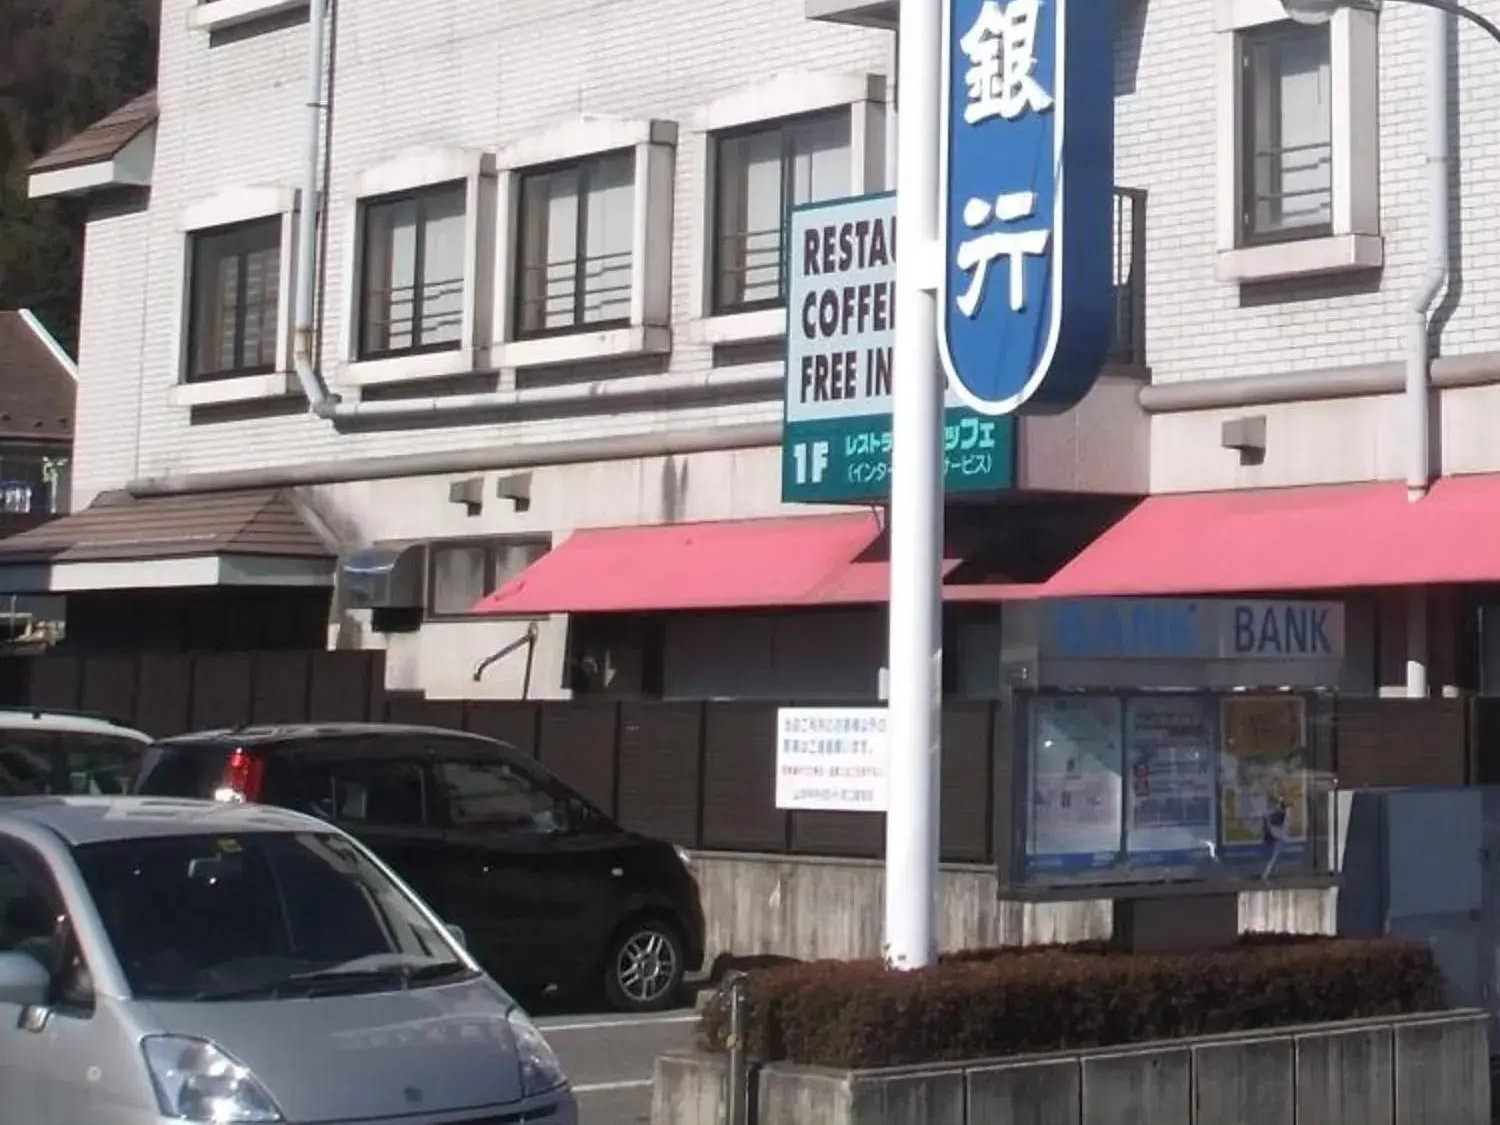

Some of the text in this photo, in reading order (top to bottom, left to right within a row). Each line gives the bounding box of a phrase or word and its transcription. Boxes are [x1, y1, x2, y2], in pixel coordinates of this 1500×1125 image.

[802, 280, 896, 340] COFFE
[800, 350, 858, 404] FREE
[793, 441, 830, 485] 1F
[1234, 604, 1333, 655] BANK
